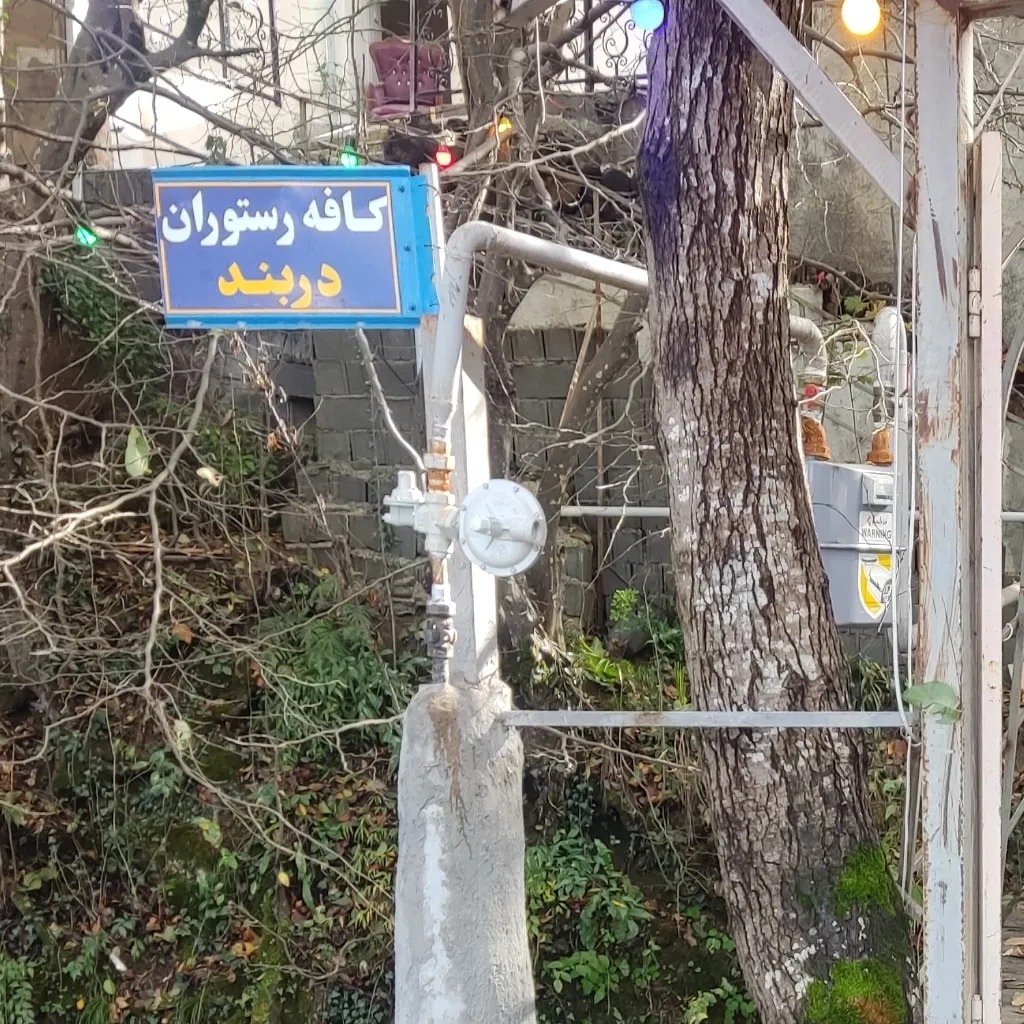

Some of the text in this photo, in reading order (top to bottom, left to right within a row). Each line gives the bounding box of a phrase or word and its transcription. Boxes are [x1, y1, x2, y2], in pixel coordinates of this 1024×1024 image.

[161, 187, 388, 246] کافه رستوران
[218, 261, 342, 309] دربند
[862, 528, 892, 539] WARNING
